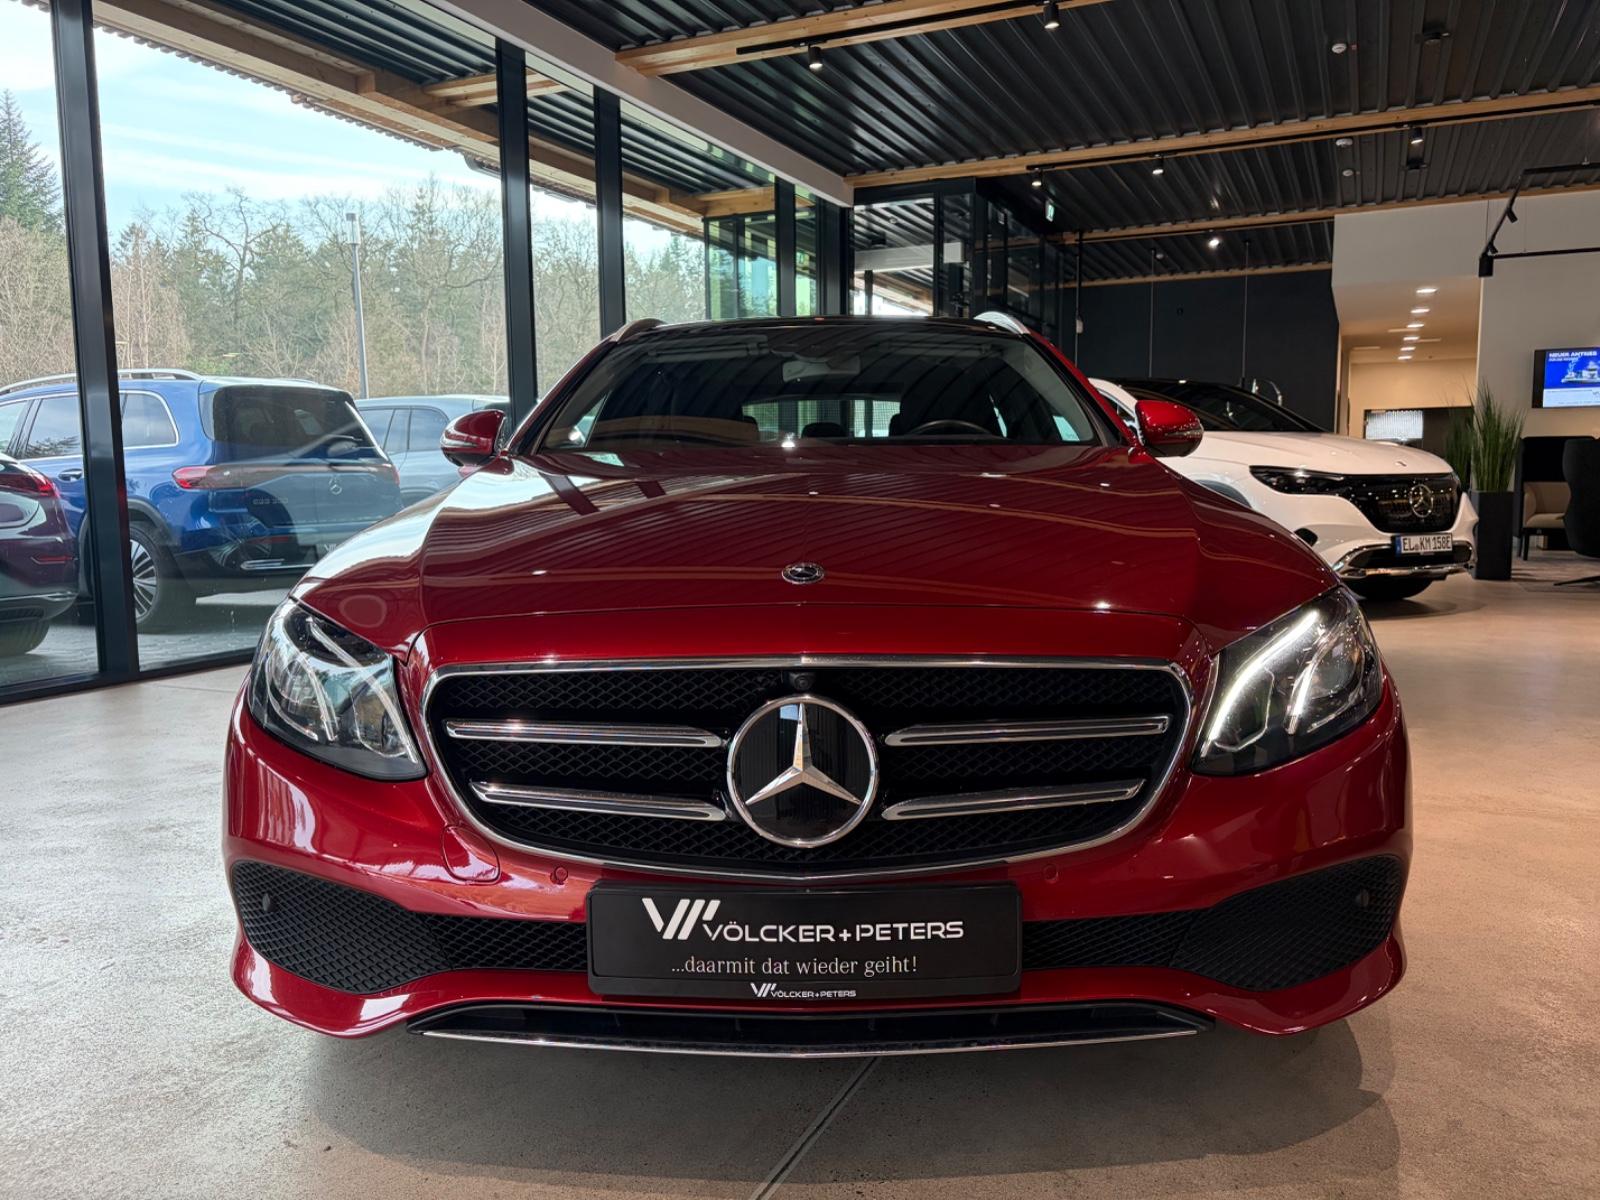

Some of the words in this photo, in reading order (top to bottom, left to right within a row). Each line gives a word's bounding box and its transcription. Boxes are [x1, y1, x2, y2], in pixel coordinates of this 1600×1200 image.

[1402, 537, 1415, 551] EL
[761, 957, 790, 975] dat
[796, 957, 858, 975] wieder
[863, 955, 917, 978] geiht!
